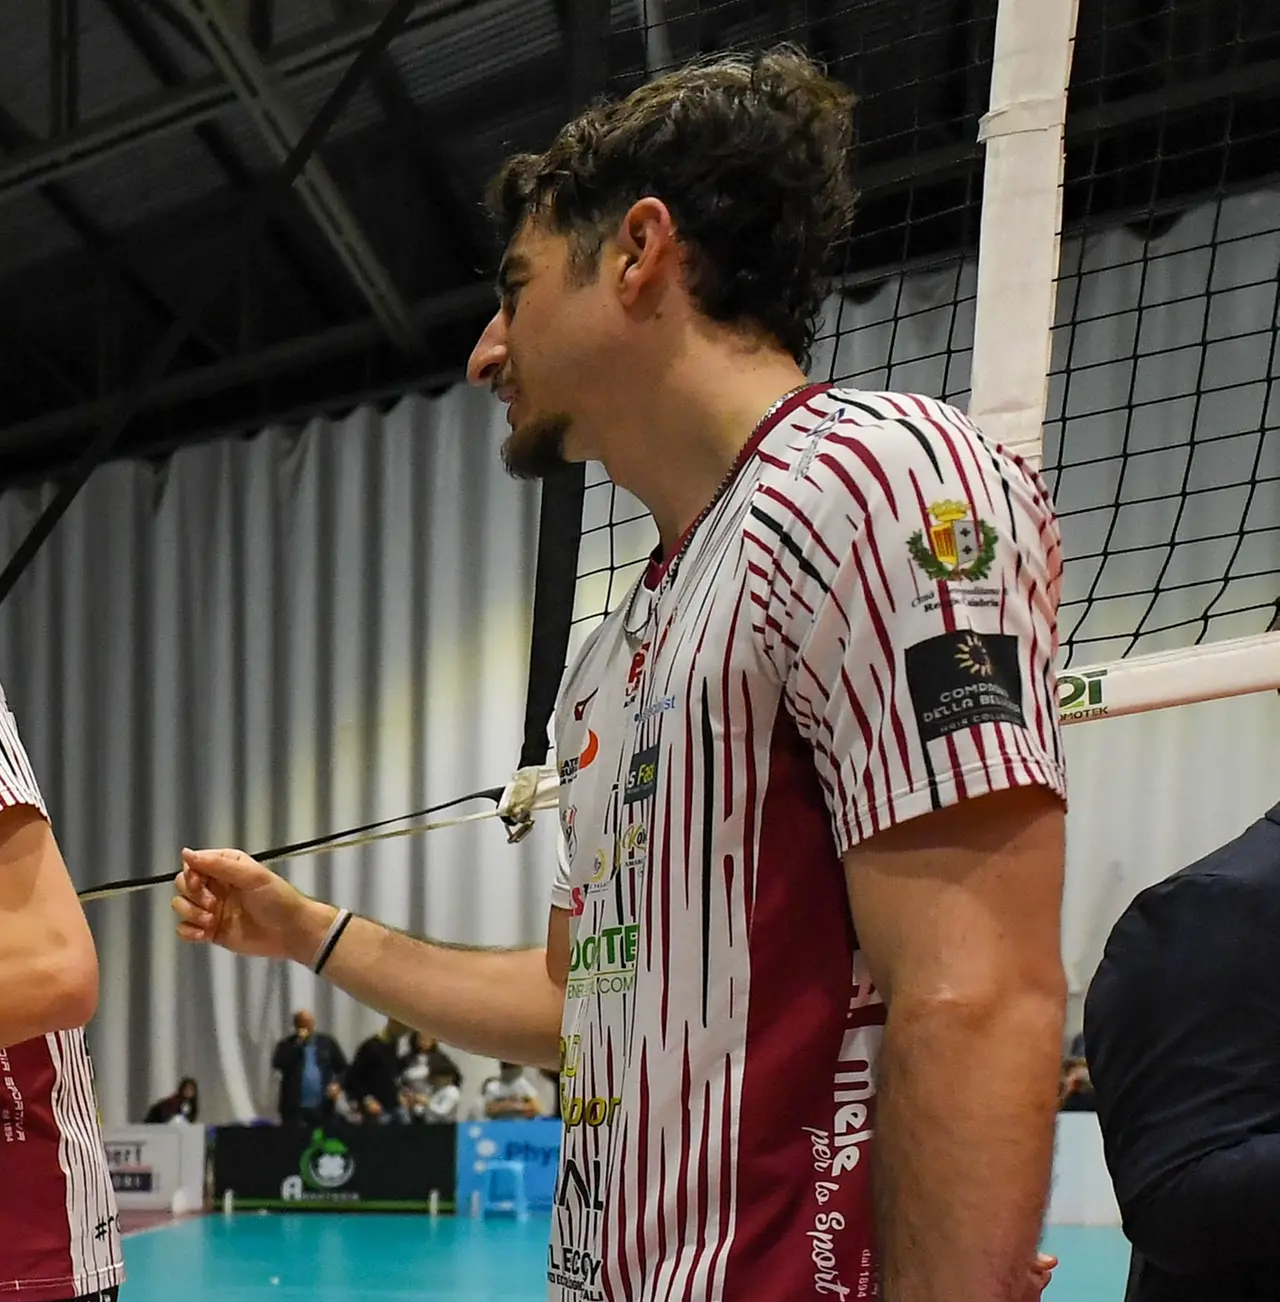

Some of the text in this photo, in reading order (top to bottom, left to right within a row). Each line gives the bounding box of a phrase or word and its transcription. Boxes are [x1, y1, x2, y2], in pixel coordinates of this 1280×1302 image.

[801, 1126, 851, 1302] per lo Sport
[857, 1270, 868, 1299] 1894
